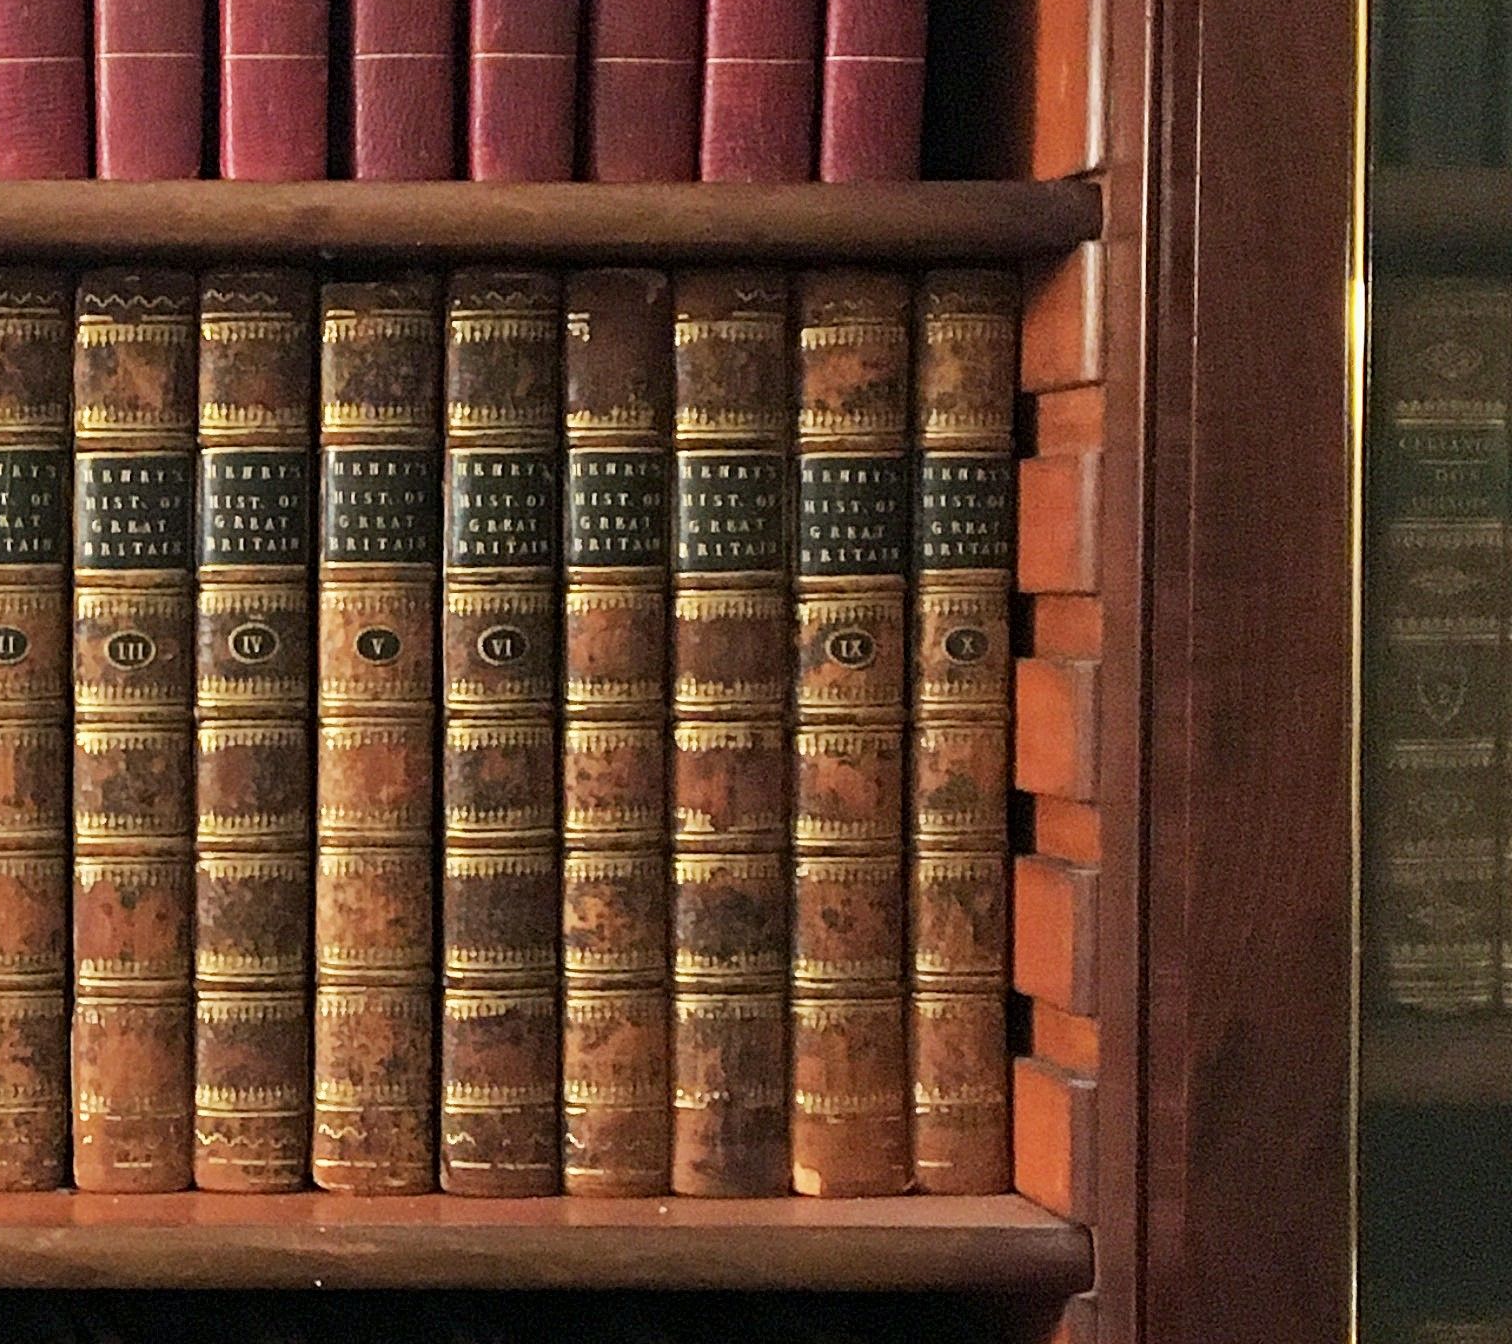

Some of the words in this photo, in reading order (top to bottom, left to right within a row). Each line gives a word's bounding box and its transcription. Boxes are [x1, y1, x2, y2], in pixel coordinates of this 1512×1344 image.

[117, 642, 144, 660] III
[243, 636, 262, 654] IV
[371, 639, 384, 655] V
[492, 639, 512, 655] VI
[840, 639, 863, 657] IX
[959, 638, 973, 653] X
